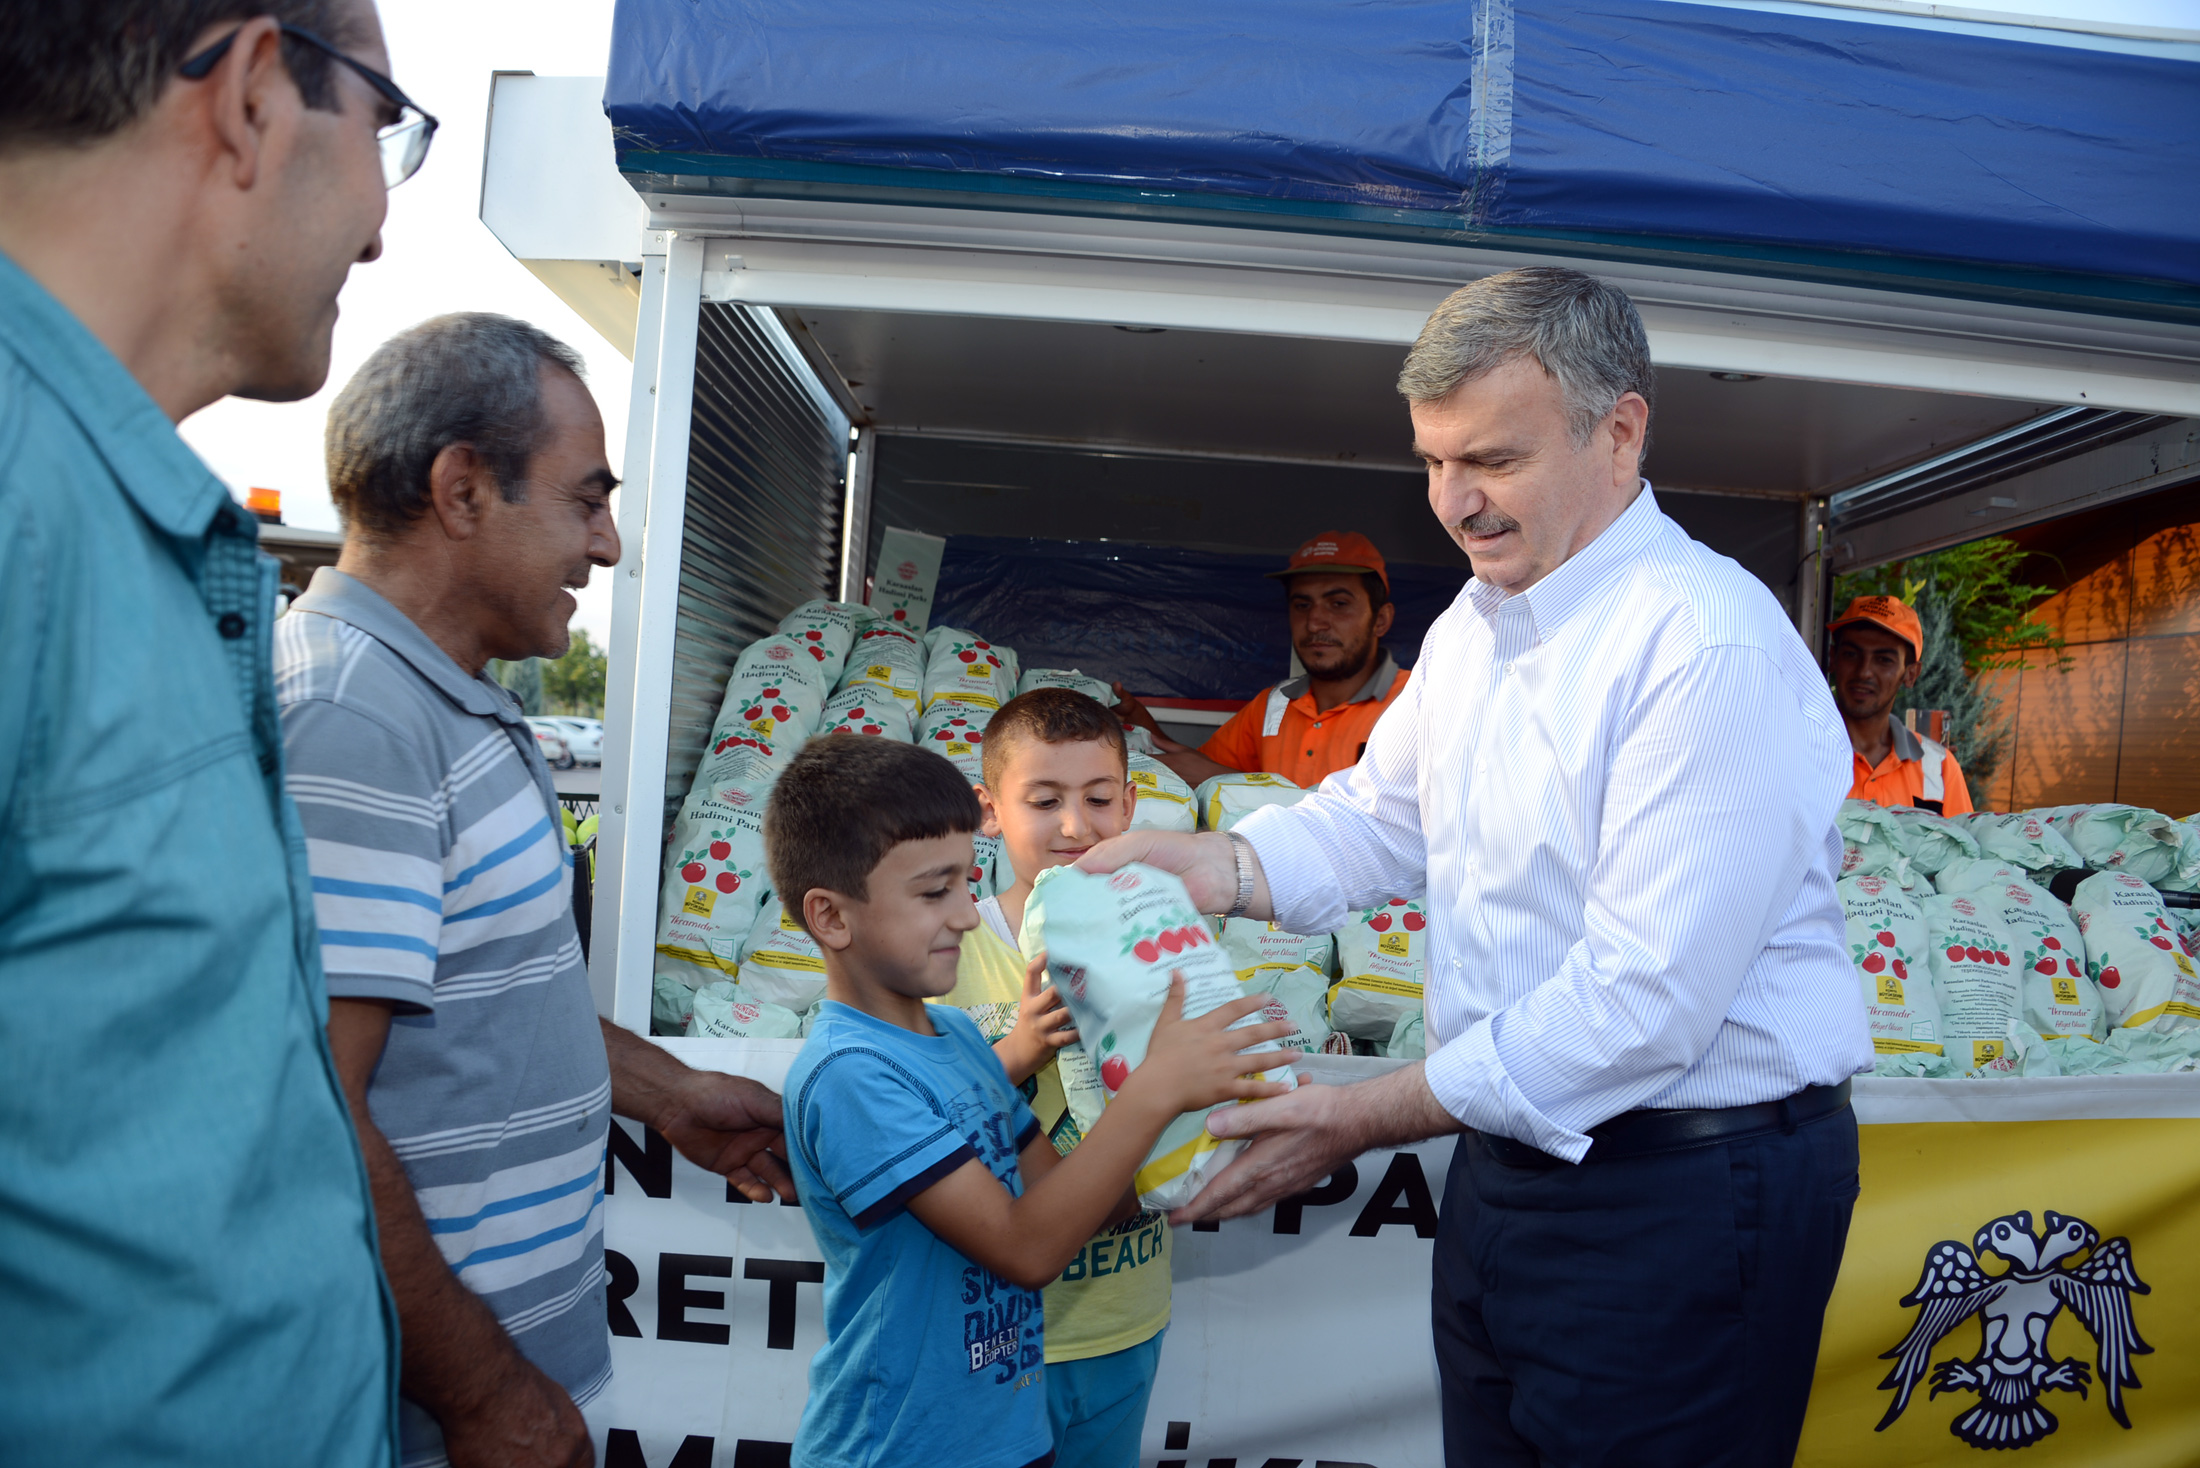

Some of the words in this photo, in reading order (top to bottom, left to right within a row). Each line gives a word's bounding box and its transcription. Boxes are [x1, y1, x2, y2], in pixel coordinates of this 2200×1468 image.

[701, 799, 762, 819] Karaaslan
[690, 811, 733, 823] Hadimi
[736, 818, 763, 834] Park
[1847, 898, 1902, 909] Karaaslan
[1845, 907, 1883, 921] Hadimi
[1886, 909, 1915, 921] Parkı
[2003, 907, 2050, 920] Karaaslan
[1949, 925, 1977, 934] Hadimi
[1952, 917, 1988, 929] Karaaslan
[714, 1018, 750, 1038] Karaasl
[1287, 1037, 1311, 1048] Parkı
[1062, 1219, 1164, 1282] BEACH
